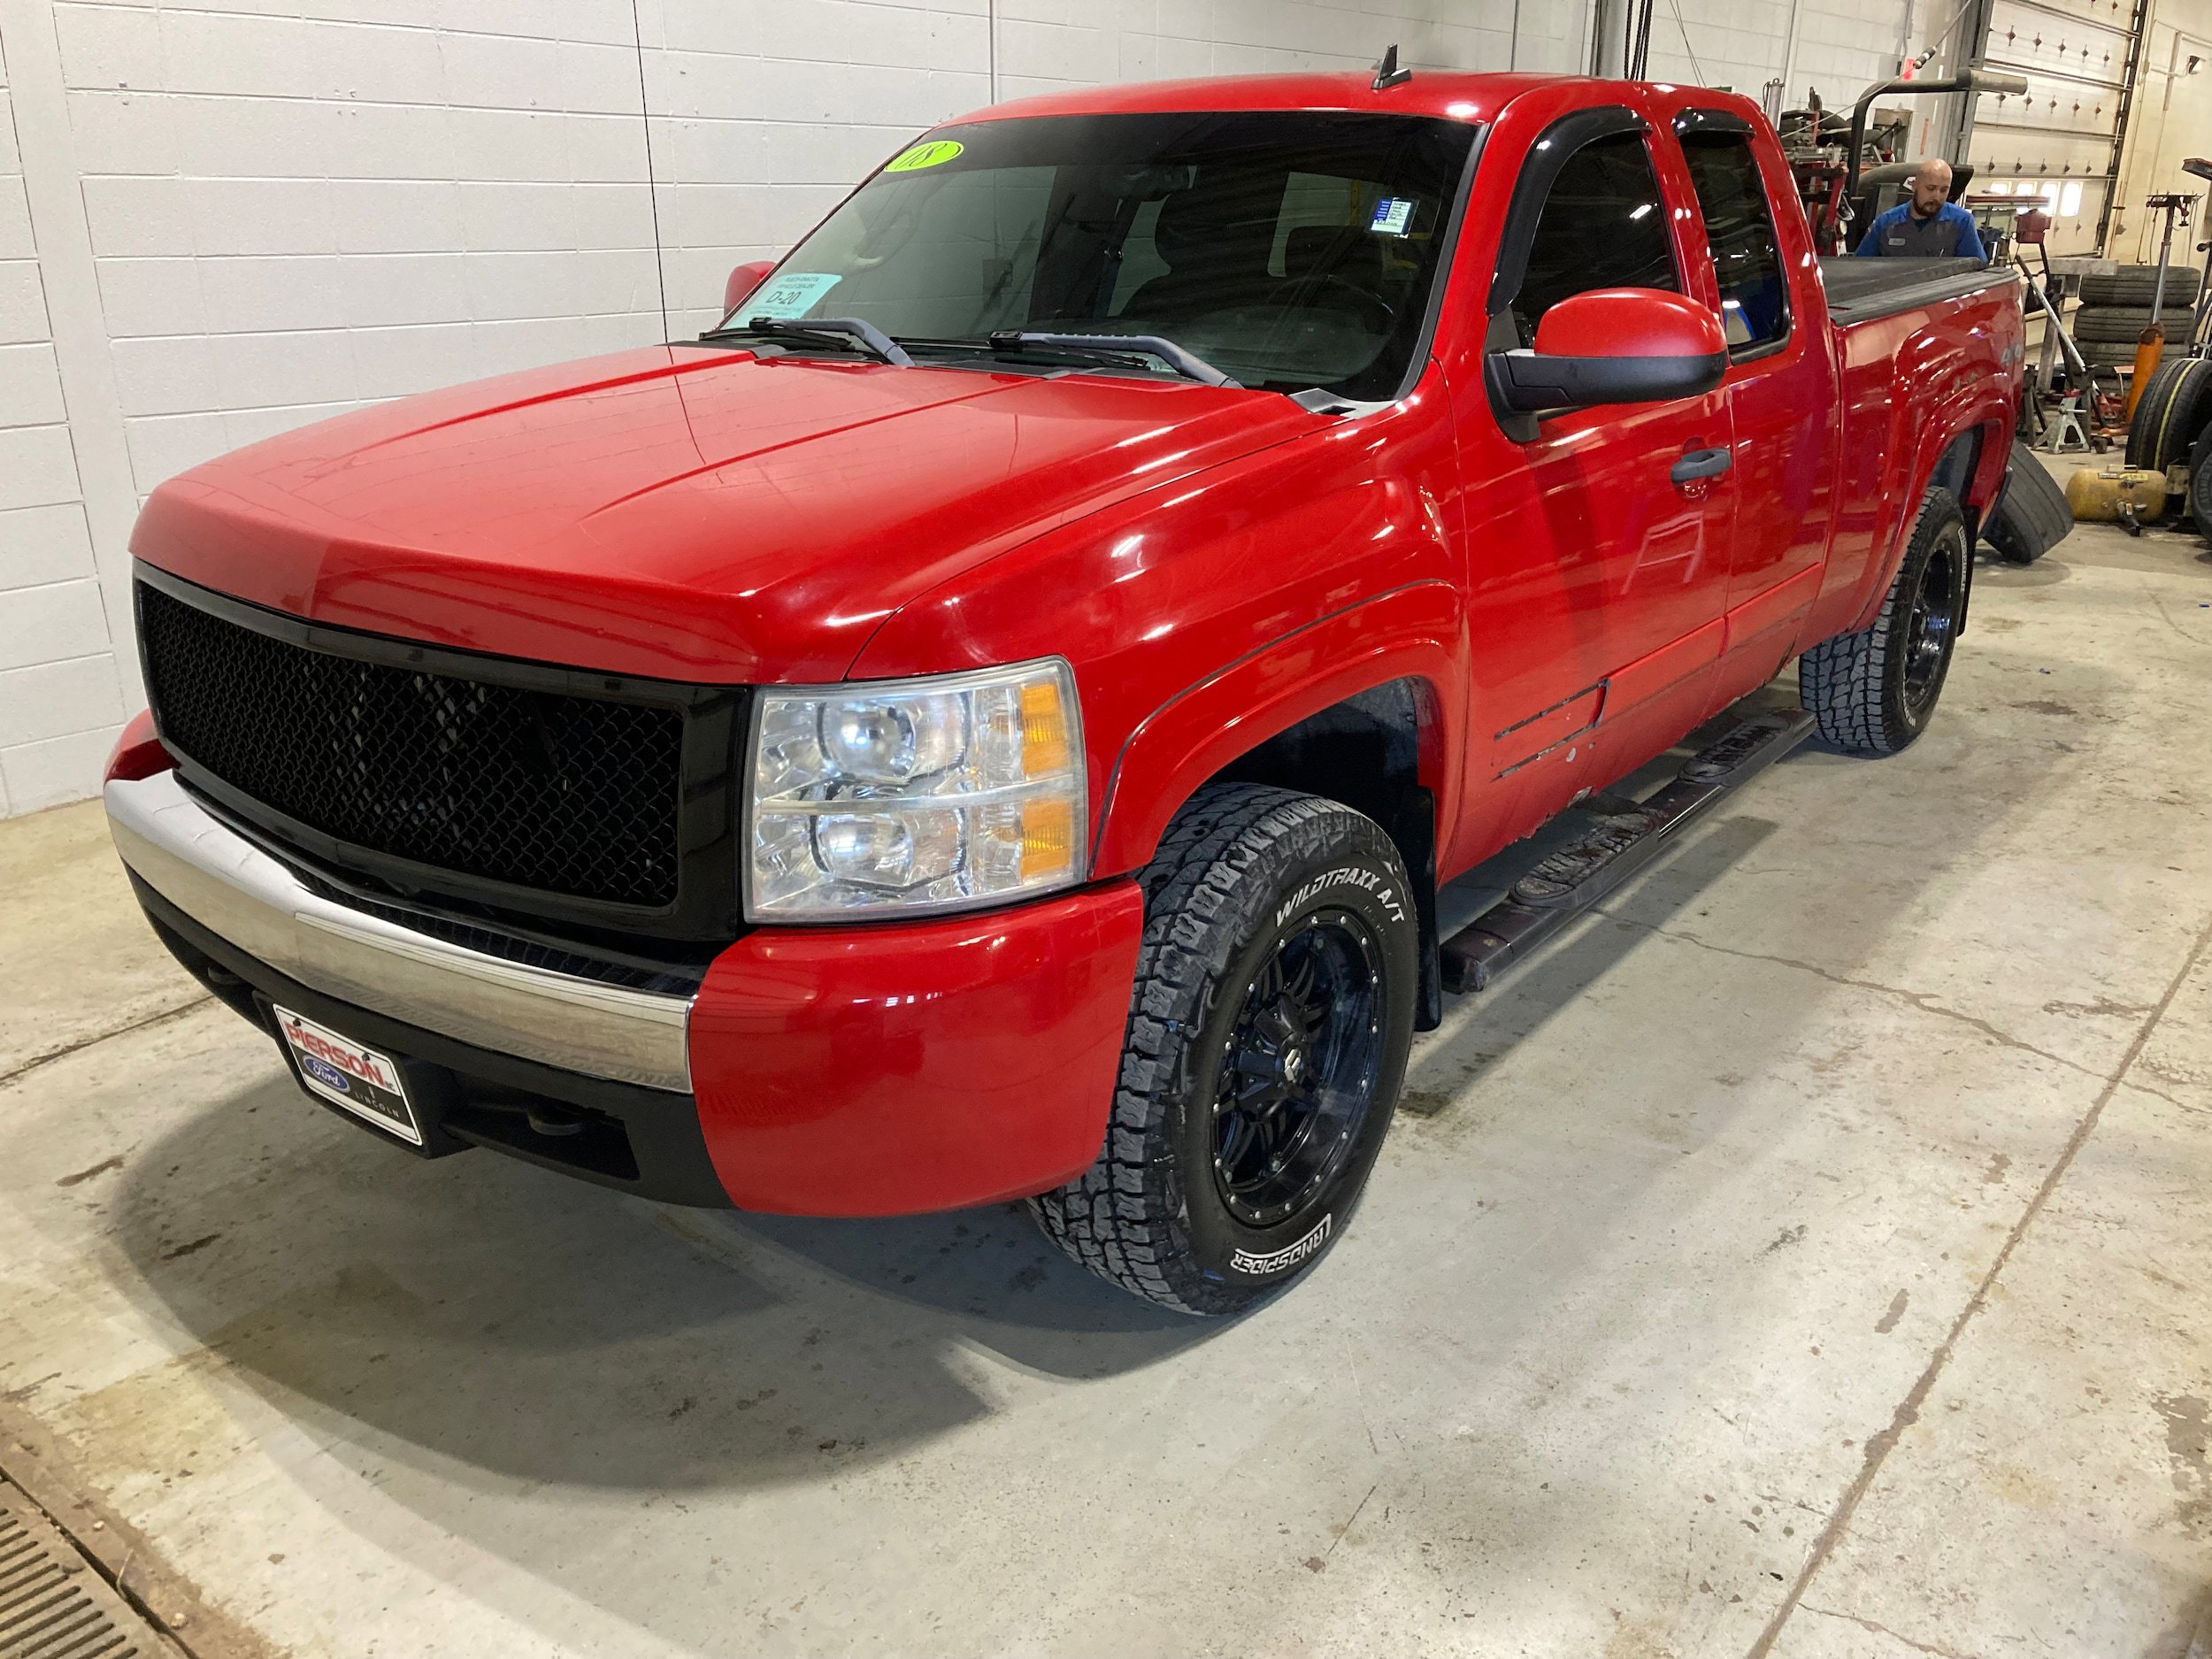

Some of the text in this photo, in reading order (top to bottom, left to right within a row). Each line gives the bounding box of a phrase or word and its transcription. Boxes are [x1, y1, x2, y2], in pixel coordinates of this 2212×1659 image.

[765, 291, 802, 305] D-20
[1276, 867, 1381, 927] WILDTRAXX
[1376, 887, 1405, 922] A/T
[283, 1021, 387, 1087] PIERSON
[312, 1059, 341, 1087] Ford
[354, 1091, 399, 1118] LINCOLN
[1230, 1212, 1332, 1274] LANDSPIDER
